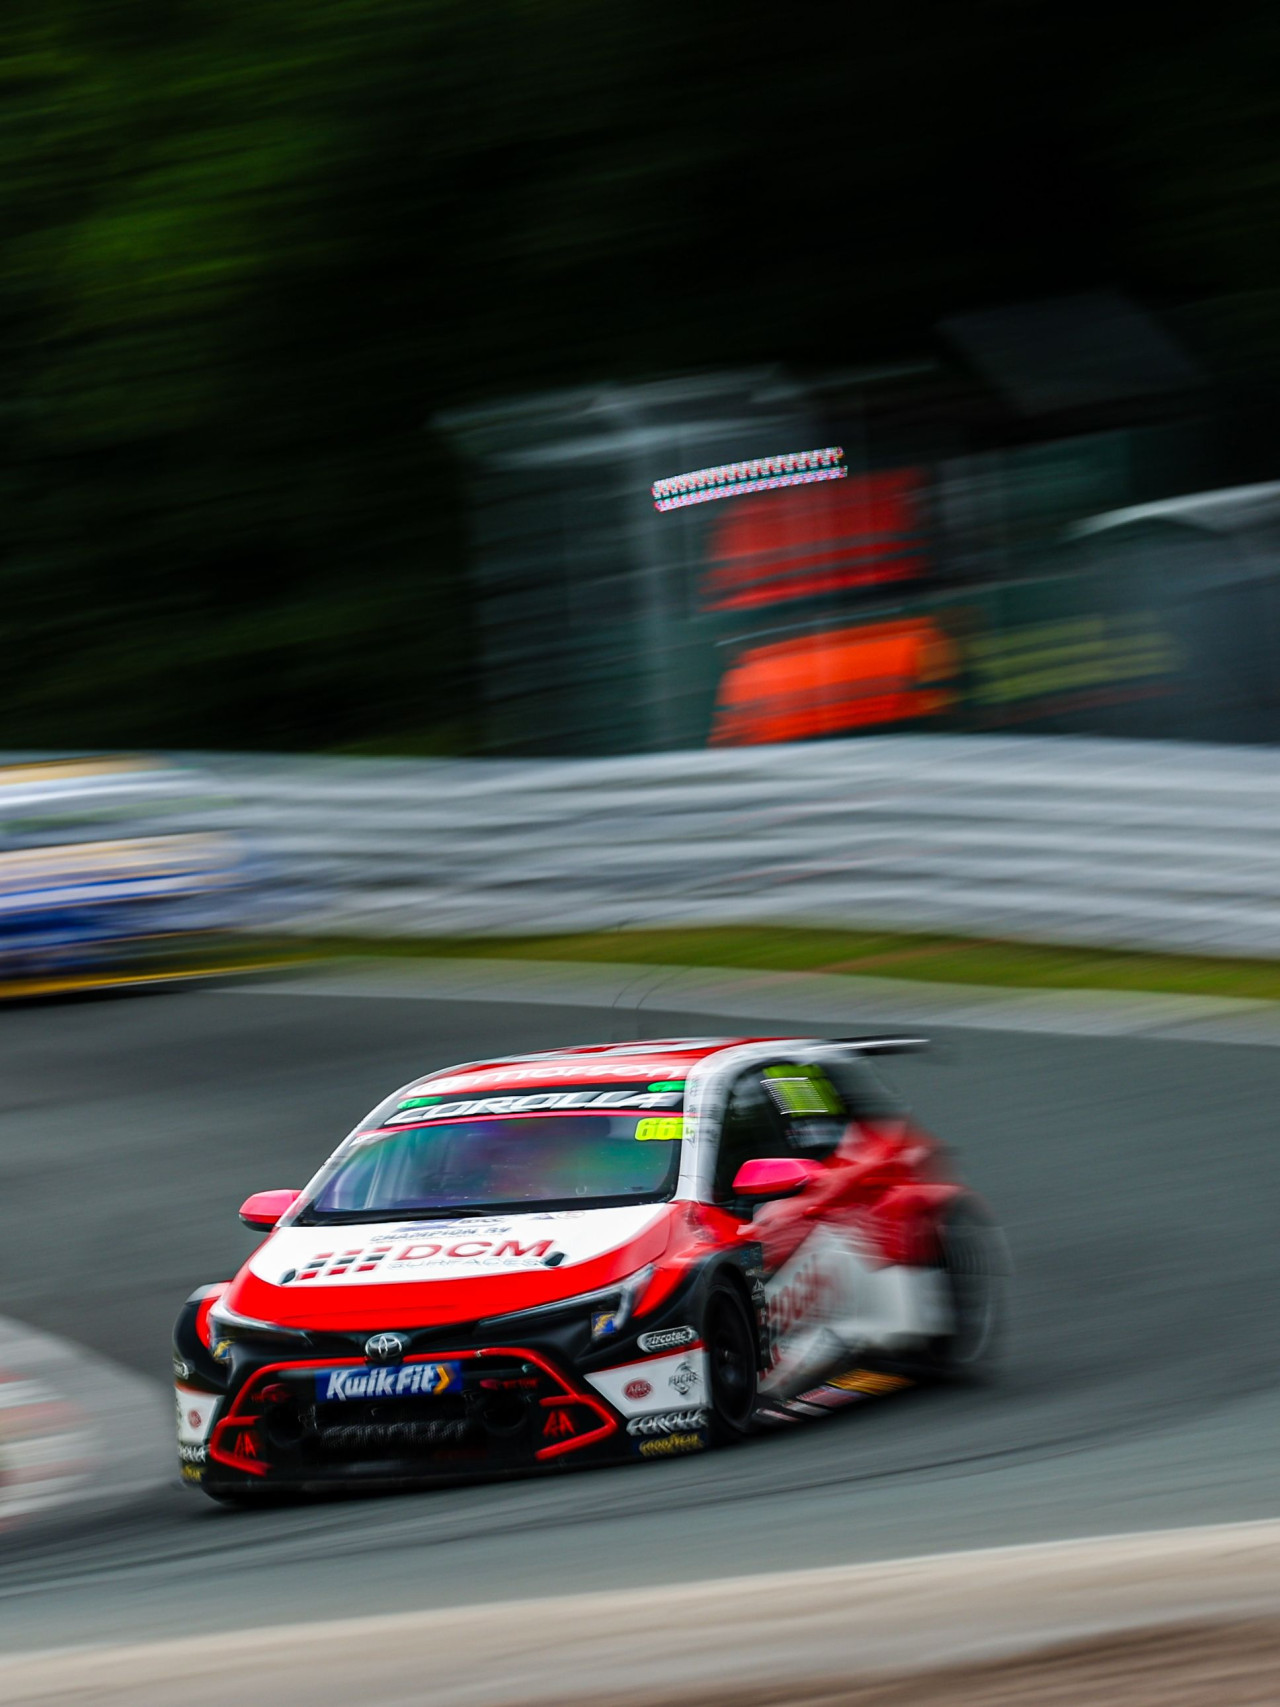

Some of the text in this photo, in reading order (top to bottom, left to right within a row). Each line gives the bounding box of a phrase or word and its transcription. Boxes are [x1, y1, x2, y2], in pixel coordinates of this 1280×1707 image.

[384, 1090, 684, 1125] COROLLA
[396, 1239, 555, 1261] DCM
[388, 1256, 546, 1269] SURFACES
